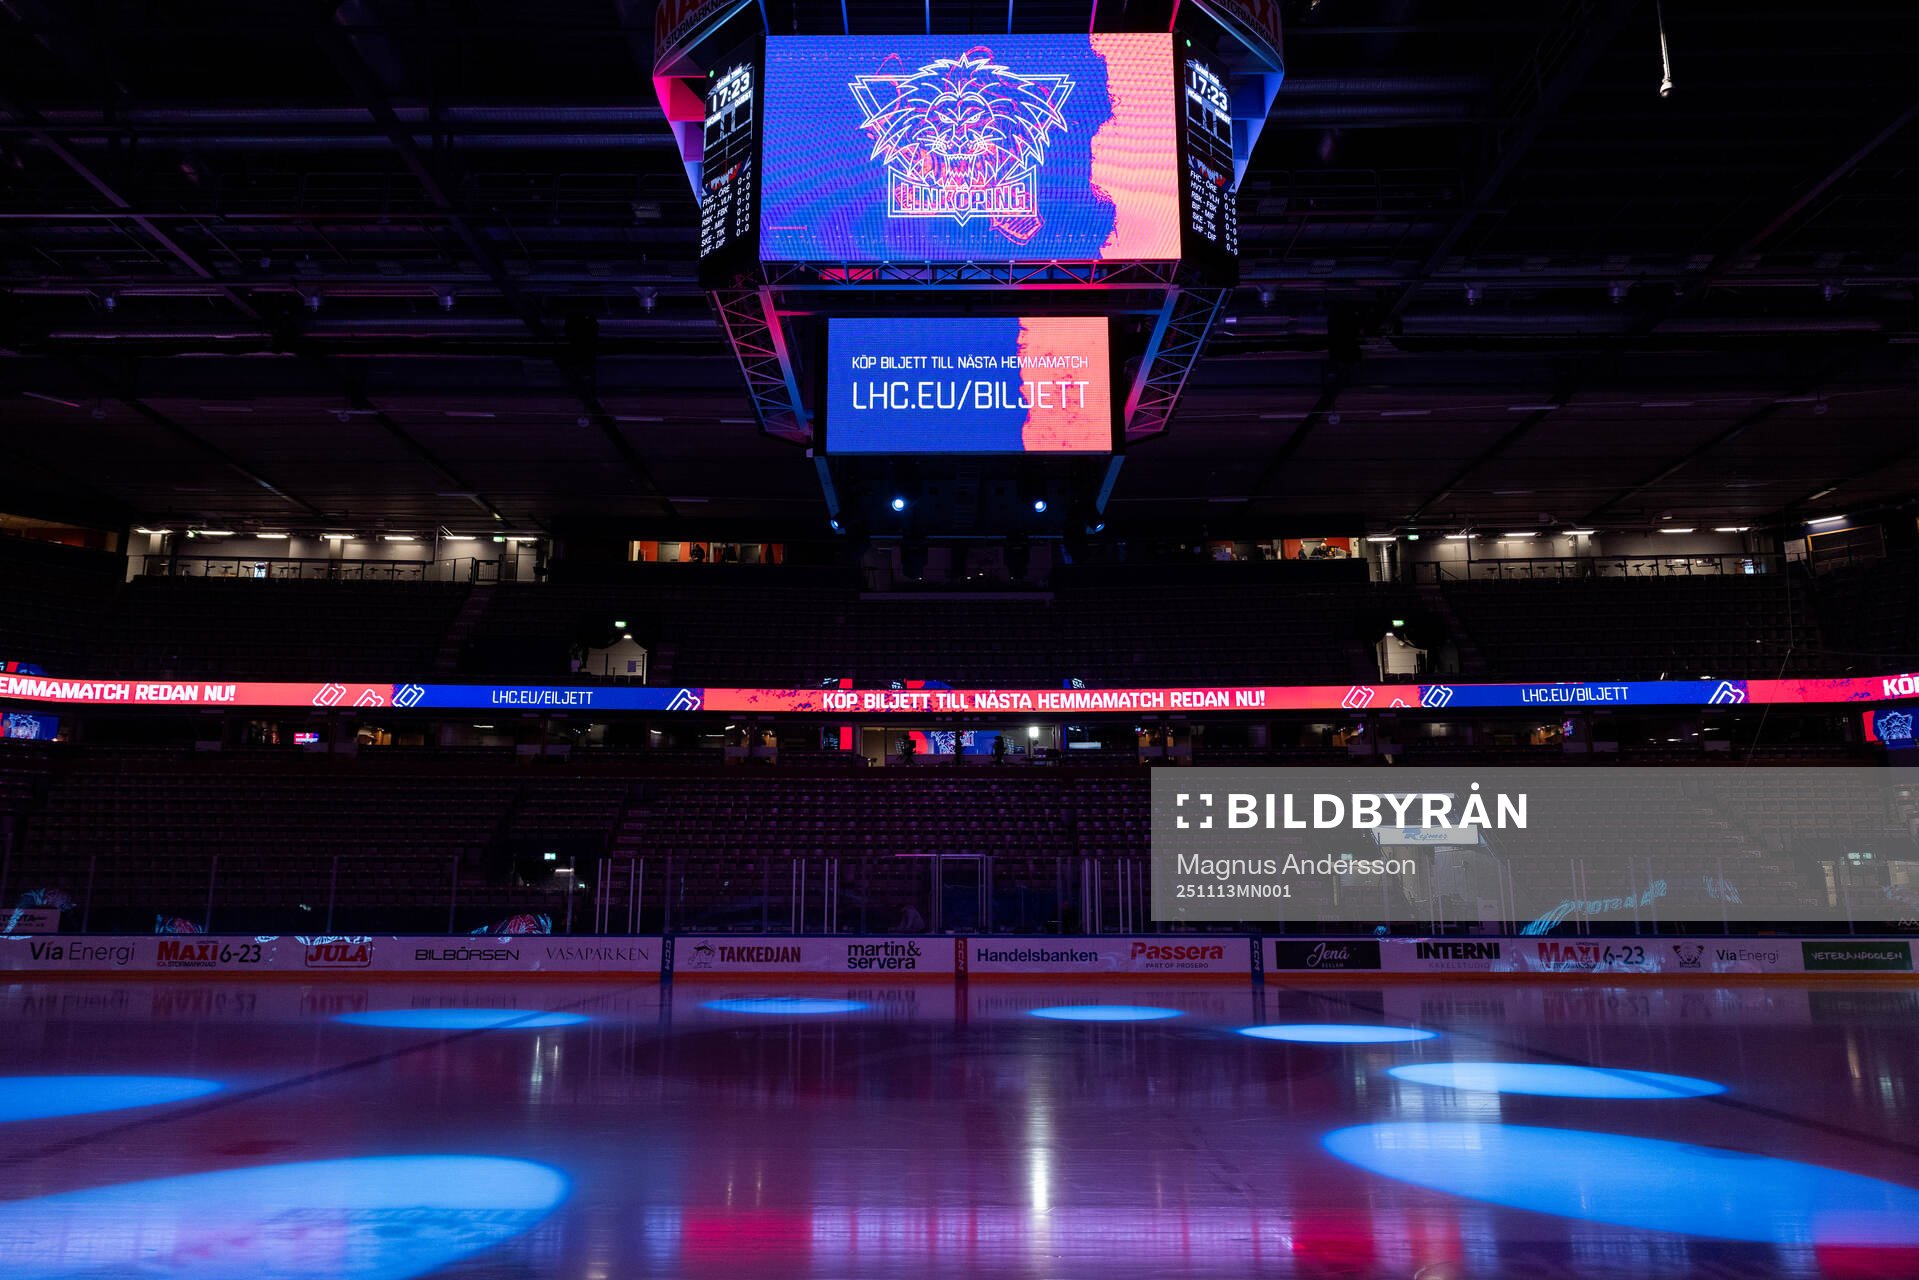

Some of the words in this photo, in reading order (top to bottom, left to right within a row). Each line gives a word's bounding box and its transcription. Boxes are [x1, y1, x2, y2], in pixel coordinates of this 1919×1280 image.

[712, 71, 750, 113] 17:23
[1192, 70, 1228, 111] 17:23
[851, 354, 877, 369] KÖP
[880, 356, 928, 369] BILJETT
[931, 356, 954, 369] TILL
[957, 354, 998, 369] NÄSTA
[1001, 355, 1088, 369] HEMMAMATCH
[852, 379, 1090, 411] LHC.EU/BILJETT
[134, 683, 199, 702] REDAN
[203, 684, 236, 702] NU!
[822, 689, 858, 710] KÖP
[864, 692, 931, 709] BILJETT
[936, 692, 969, 709] TILL
[974, 689, 1032, 710] NÄSTA
[1037, 691, 1164, 709] HEMMAMATCH
[1170, 690, 1230, 708] REDAN
[1235, 690, 1266, 707] NU!
[1521, 686, 1630, 703] LHC.EU/BILJETT
[69, 942, 136, 966] Energi
[219, 943, 262, 963] 6-23
[307, 944, 368, 962] JULA
[414, 945, 520, 961] BILBÖRSEN
[545, 946, 650, 961] VASAPARKEN
[719, 946, 801, 963] TAKKEDJAN
[847, 940, 921, 957] martin&
[976, 948, 1099, 963] Handelsbanken
[1130, 942, 1224, 961] Passera
[1416, 942, 1500, 960] INTERNI
[1602, 945, 1645, 965] 6-23
[1738, 949, 1780, 964] Energi
[1810, 951, 1904, 961] VETERANPOOLEN
[847, 955, 916, 969] servera
